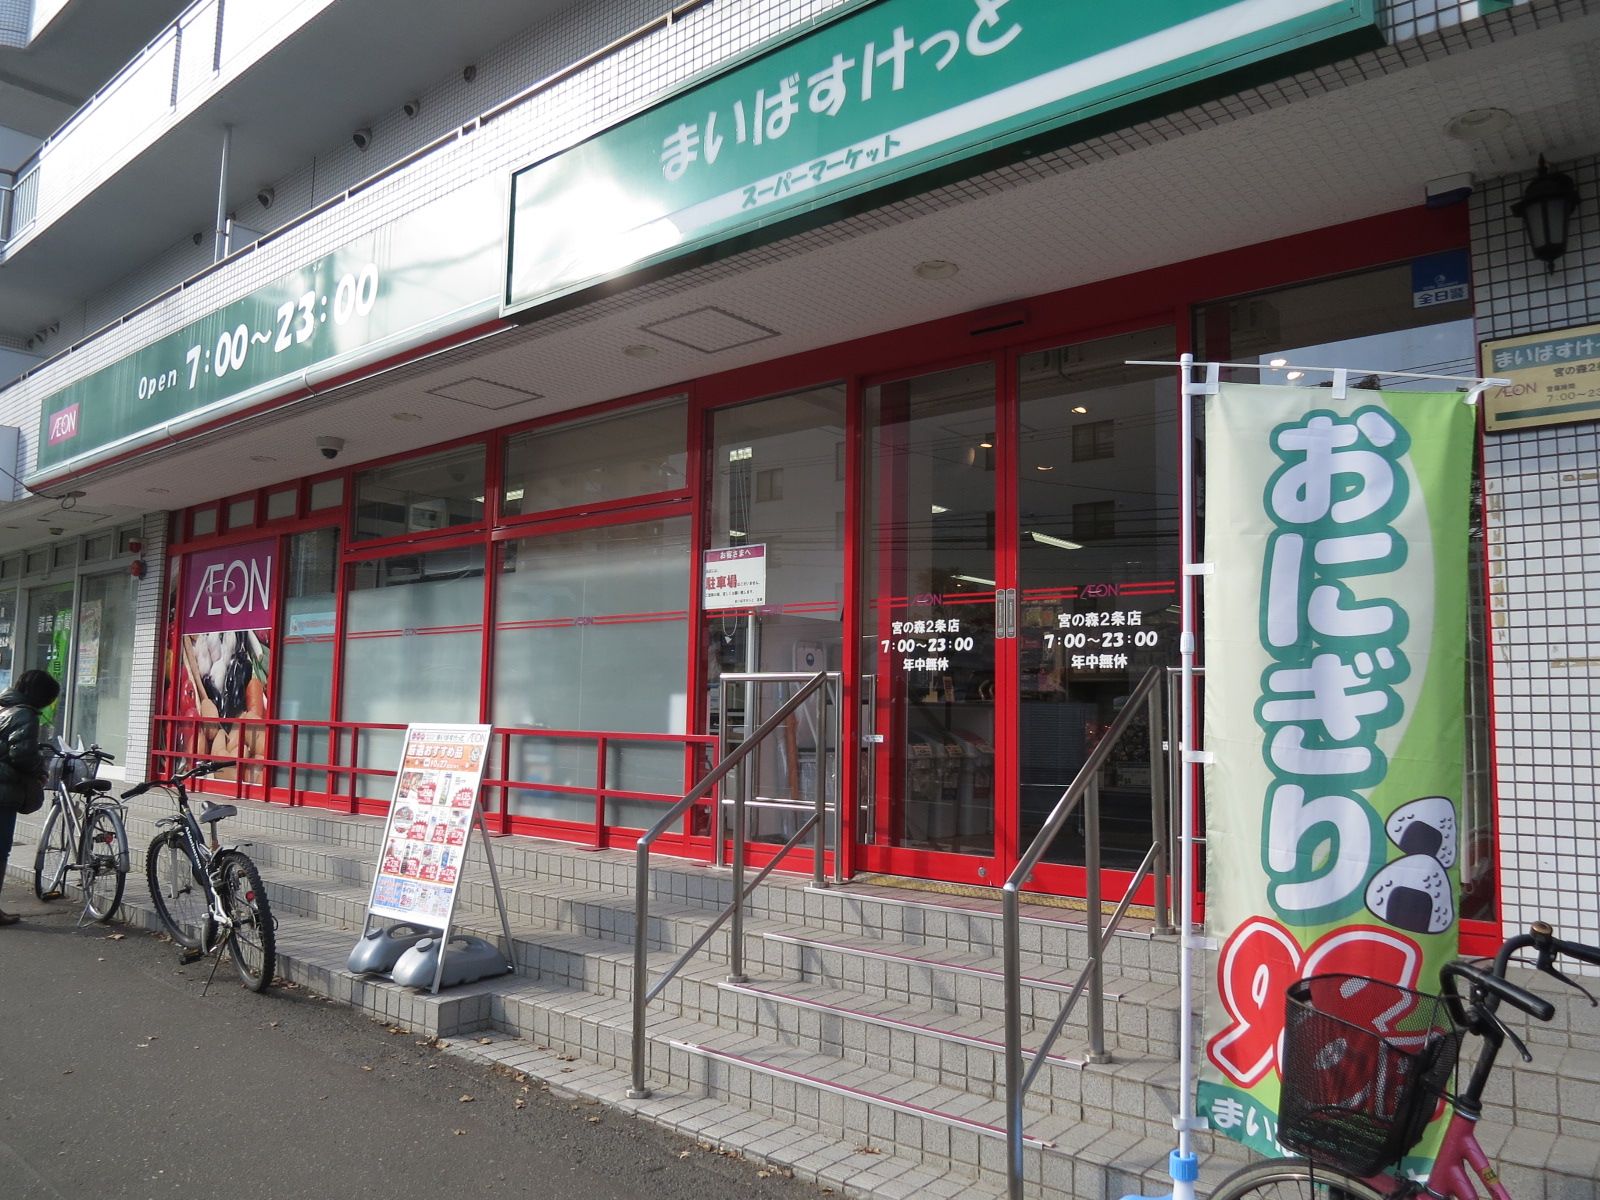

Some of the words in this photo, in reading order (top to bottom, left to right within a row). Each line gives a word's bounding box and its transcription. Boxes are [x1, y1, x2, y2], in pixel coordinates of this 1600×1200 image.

[659, 0, 1023, 182] まいばすけっと
[740, 135, 902, 209] スーパーマーケット
[137, 366, 179, 401] Open
[705, 574, 738, 591] 駐車場
[891, 618, 961, 635] 宮の森2条店
[1057, 610, 1142, 628] 宮の森2条店
[902, 657, 950, 671] 年中無休
[1071, 653, 1129, 669] 年中無休
[1255, 405, 1411, 927] おにぎり
